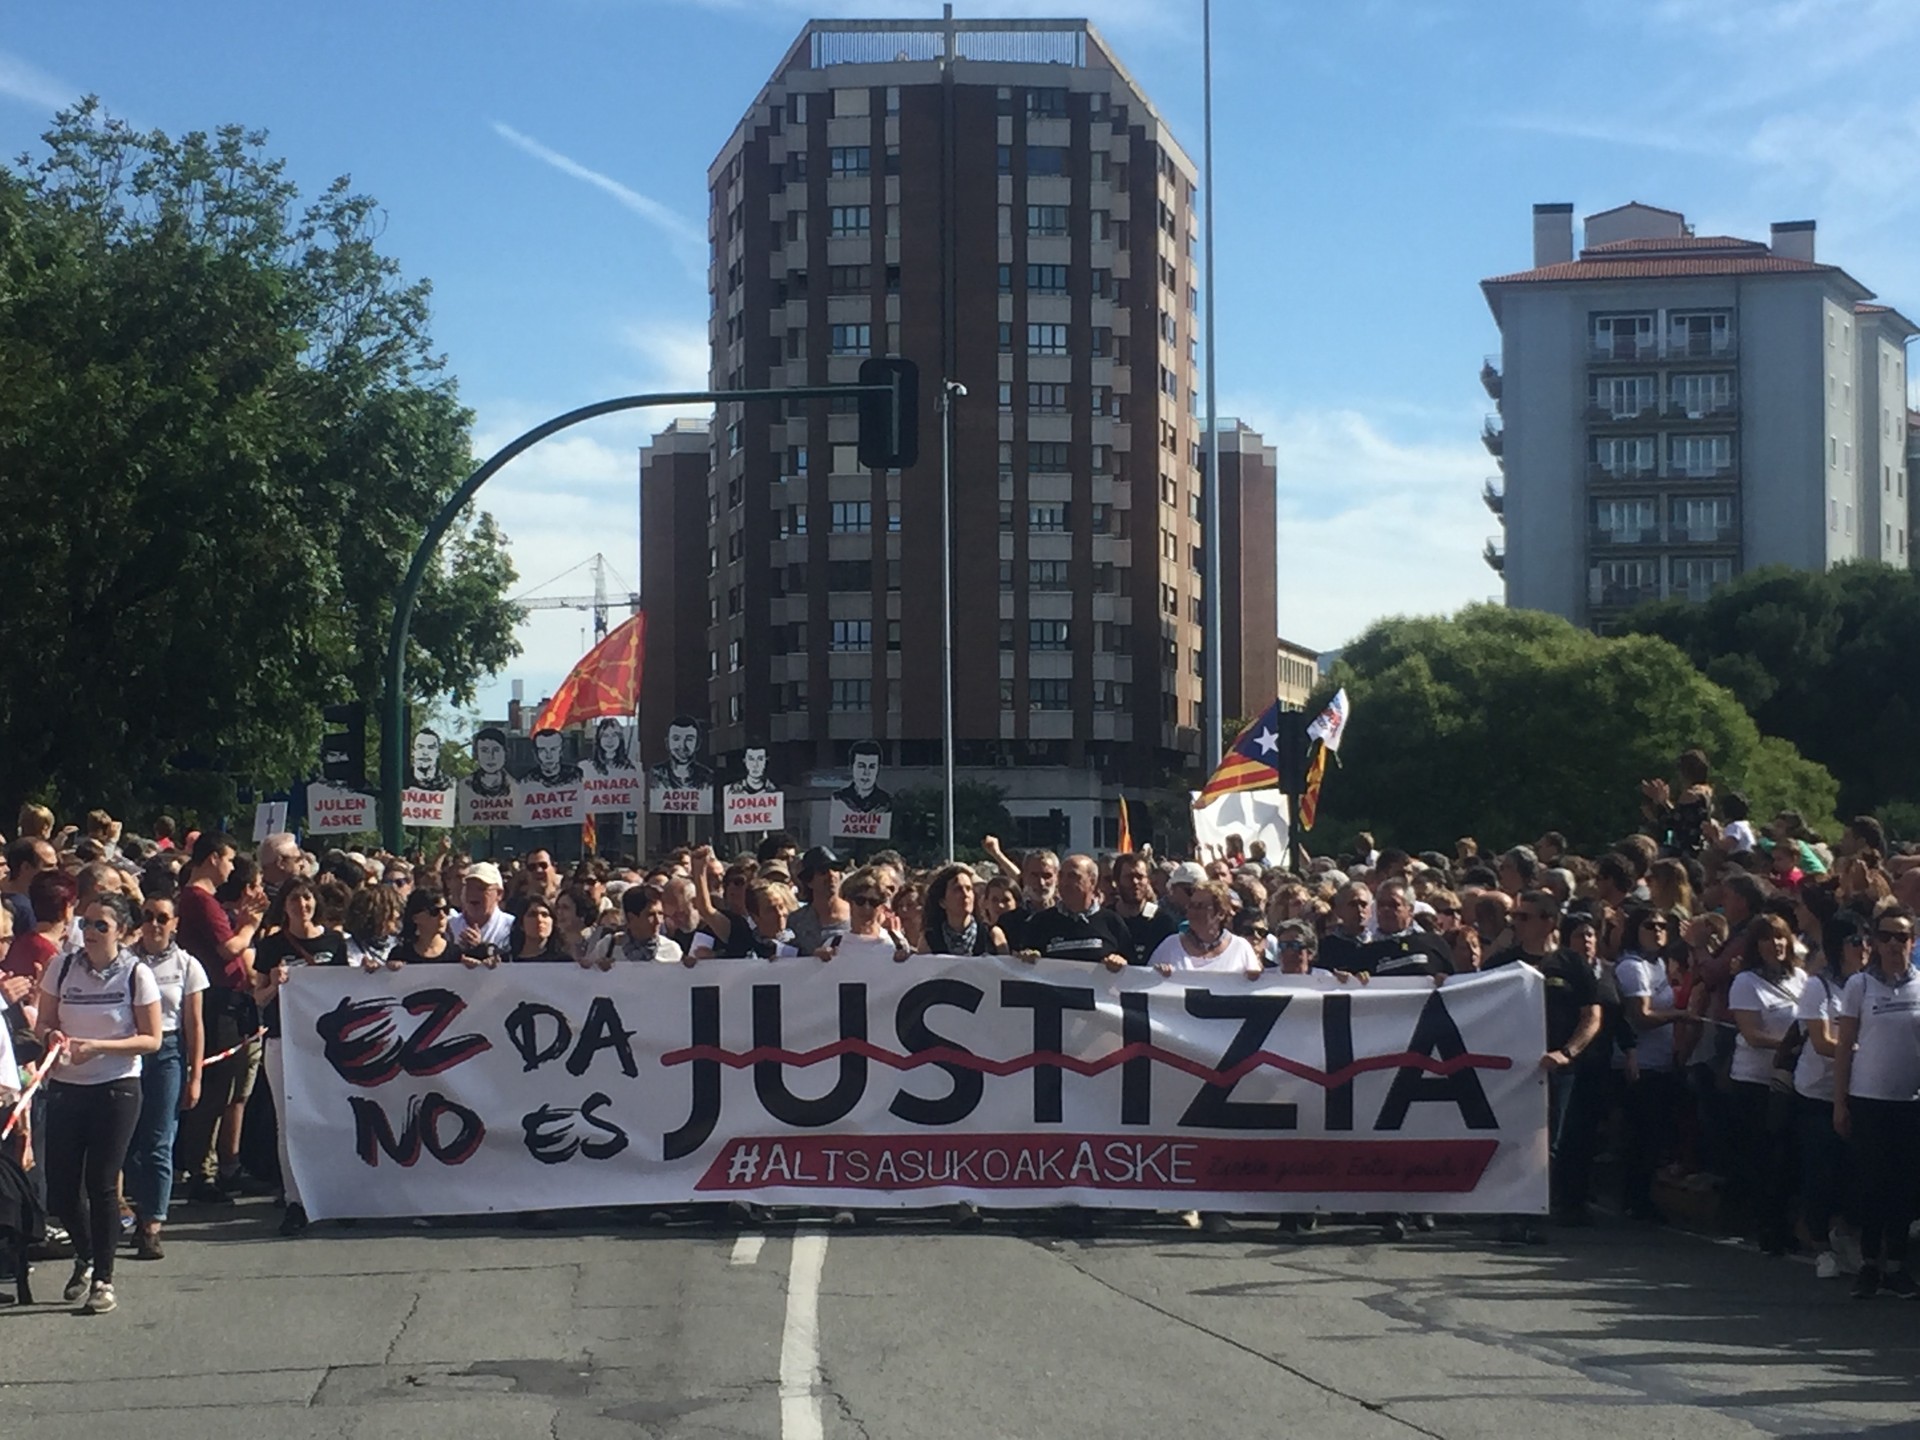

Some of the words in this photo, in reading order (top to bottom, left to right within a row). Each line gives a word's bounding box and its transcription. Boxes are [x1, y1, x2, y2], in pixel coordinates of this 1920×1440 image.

[584, 778, 639, 790] AINARA
[525, 790, 577, 805] ARATZ
[592, 793, 631, 805] ASKE
[663, 791, 699, 800] ADUR
[315, 799, 367, 811] JULEN
[664, 801, 699, 811] ASKE
[728, 796, 777, 809] JONAN
[402, 807, 442, 819] ASKE
[473, 811, 509, 820] ASKE
[531, 806, 573, 820] ASKE
[733, 812, 772, 825] ASKE
[320, 815, 362, 827] ASKE
[843, 824, 877, 834] ASKE
[316, 989, 493, 1087] EZ
[506, 997, 638, 1078] DA
[662, 979, 1500, 1161] JUSTIZIA
[347, 1093, 486, 1167] NO
[522, 1093, 629, 1164] ES
[727, 1142, 1198, 1184] #ALTSASUKOAKASKE
